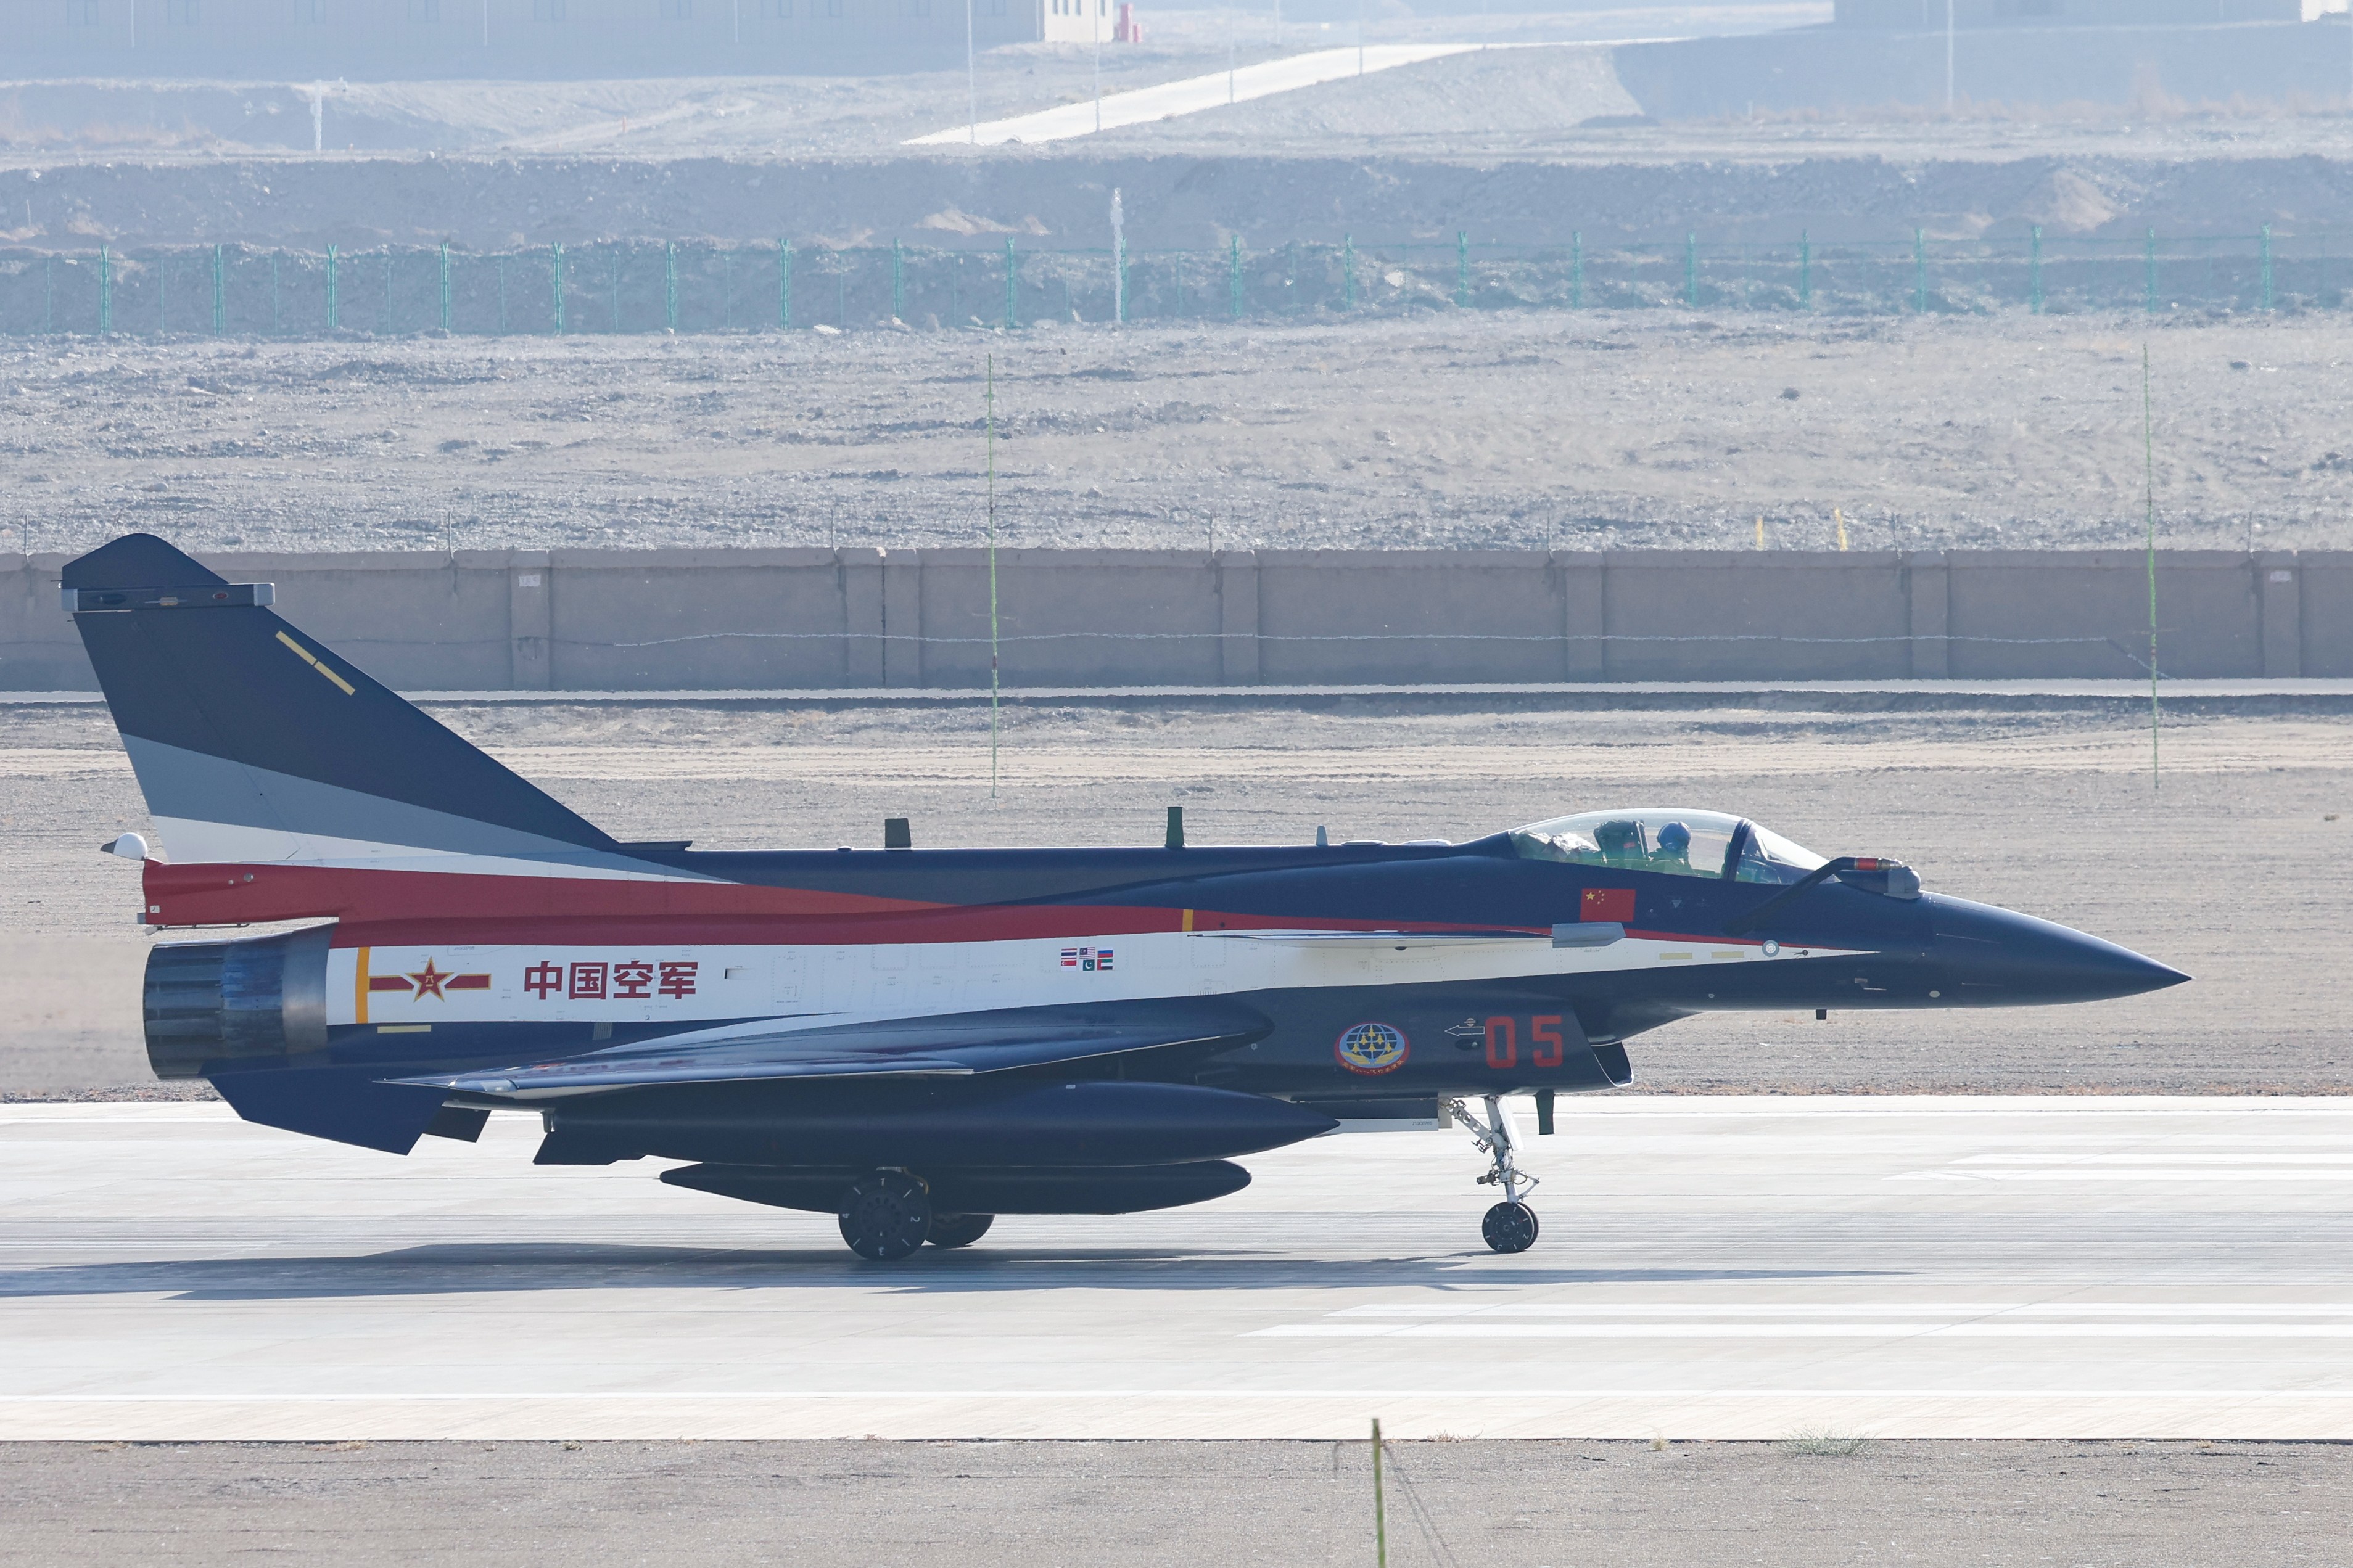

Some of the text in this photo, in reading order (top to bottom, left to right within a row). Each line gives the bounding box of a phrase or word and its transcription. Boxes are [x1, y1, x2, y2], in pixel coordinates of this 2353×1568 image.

[524, 960, 698, 1000] 中国空军
[1485, 1015, 1563, 1069] 05
